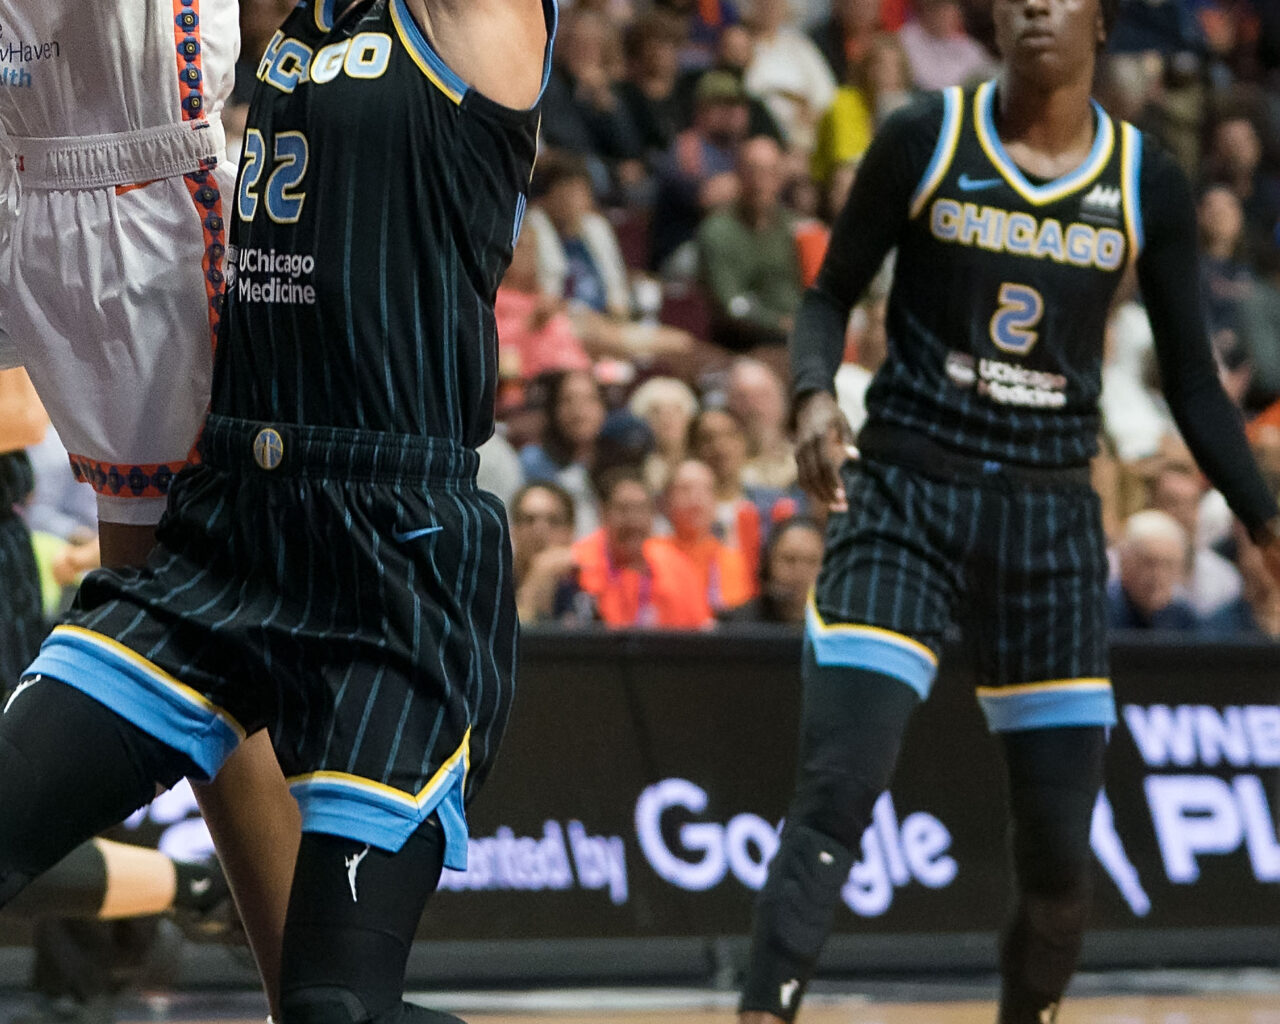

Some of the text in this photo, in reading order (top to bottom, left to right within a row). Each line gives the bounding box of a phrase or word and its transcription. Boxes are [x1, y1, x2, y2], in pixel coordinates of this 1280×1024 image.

[237, 128, 309, 224] 22
[238, 247, 316, 277] UChicago
[930, 198, 1126, 272] CHICAGO
[238, 276, 317, 305] Medicine
[989, 282, 1044, 355] 2
[438, 820, 571, 892] ented
[634, 777, 959, 918] Gogle
